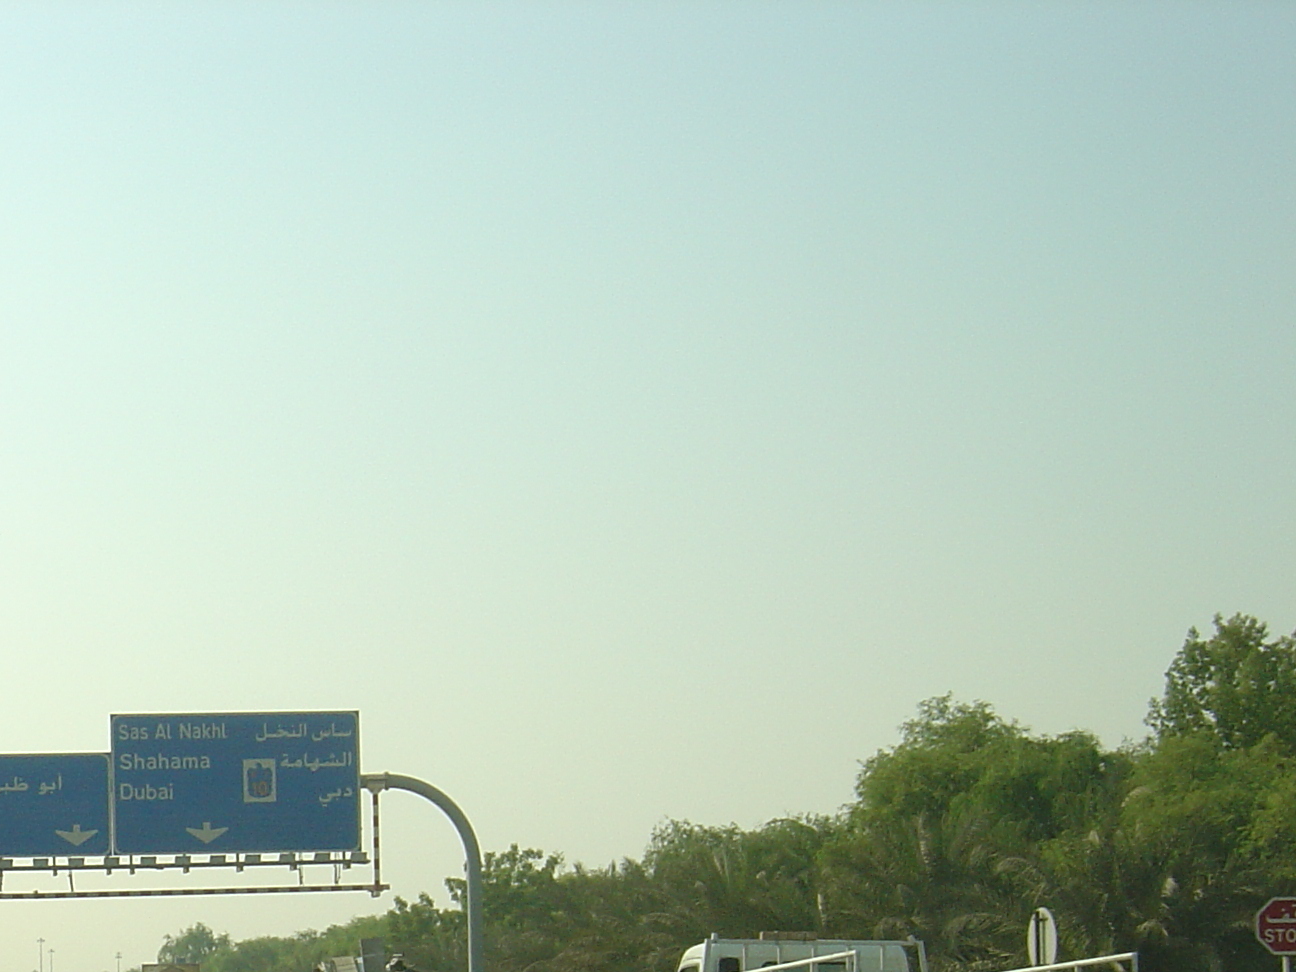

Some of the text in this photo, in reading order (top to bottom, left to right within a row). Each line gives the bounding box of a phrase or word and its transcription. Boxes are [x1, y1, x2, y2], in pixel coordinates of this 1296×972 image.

[118, 722, 228, 741] Sas Al Nakhl
[255, 722, 352, 742] ساس النخل
[119, 753, 211, 771] Shahama
[280, 751, 352, 772] الشهامة
[119, 783, 174, 801] Dubai
[318, 787, 353, 807] دبي
[1264, 928, 1296, 943] STO
